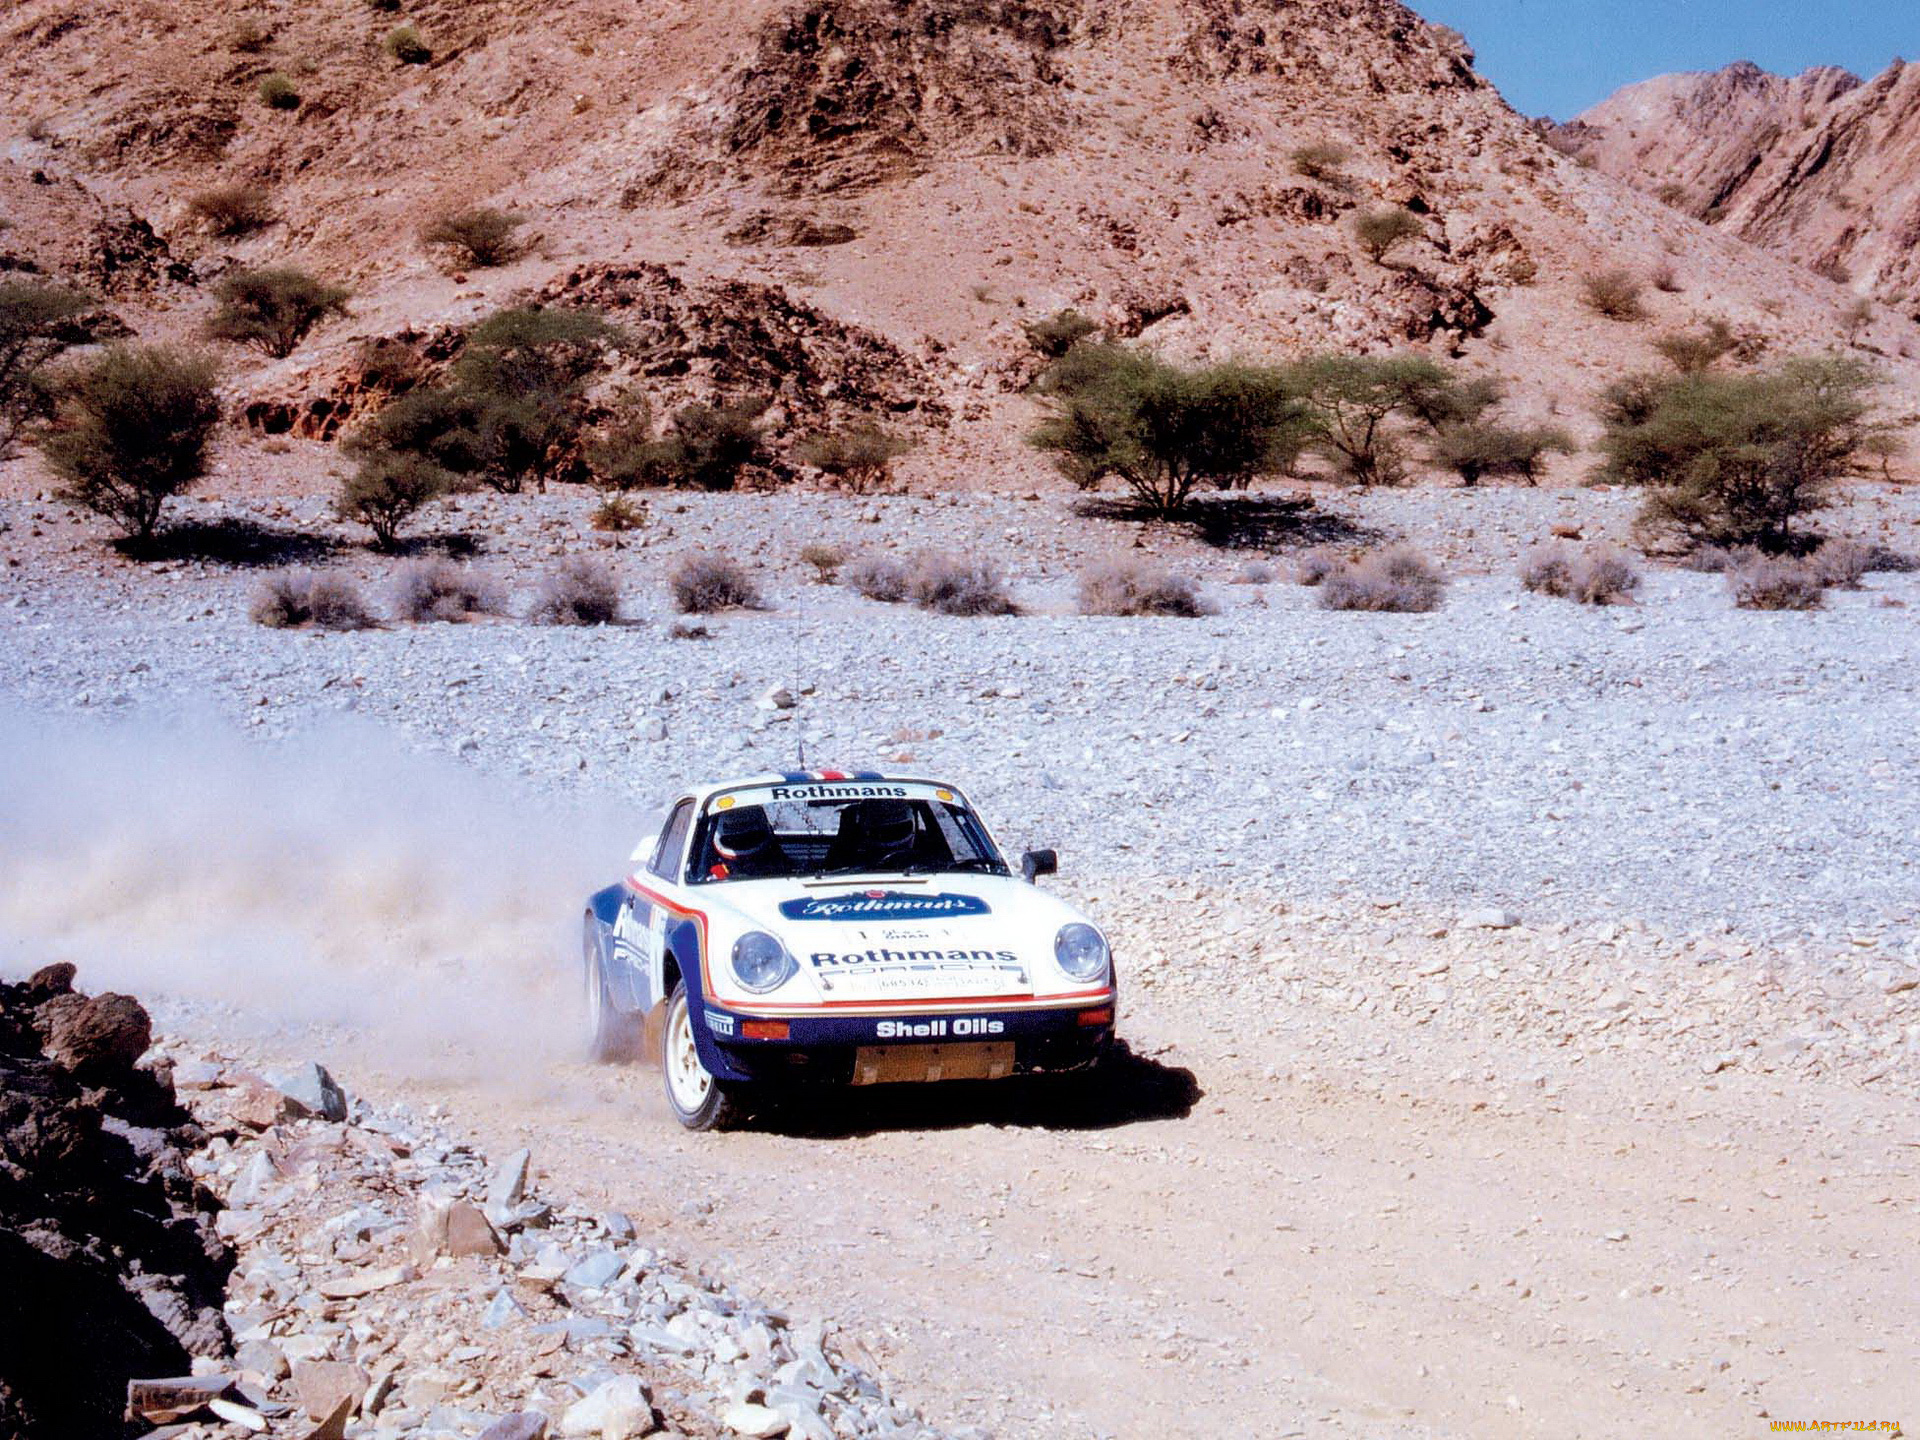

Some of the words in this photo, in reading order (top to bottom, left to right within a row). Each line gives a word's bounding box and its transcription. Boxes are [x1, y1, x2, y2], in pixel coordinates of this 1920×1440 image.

[771, 786, 907, 800] Rothmans
[802, 899, 975, 915] Rothmans
[810, 949, 1018, 967] Rothmans
[876, 1020, 947, 1037] Shell
[952, 1017, 1004, 1035] Oils
